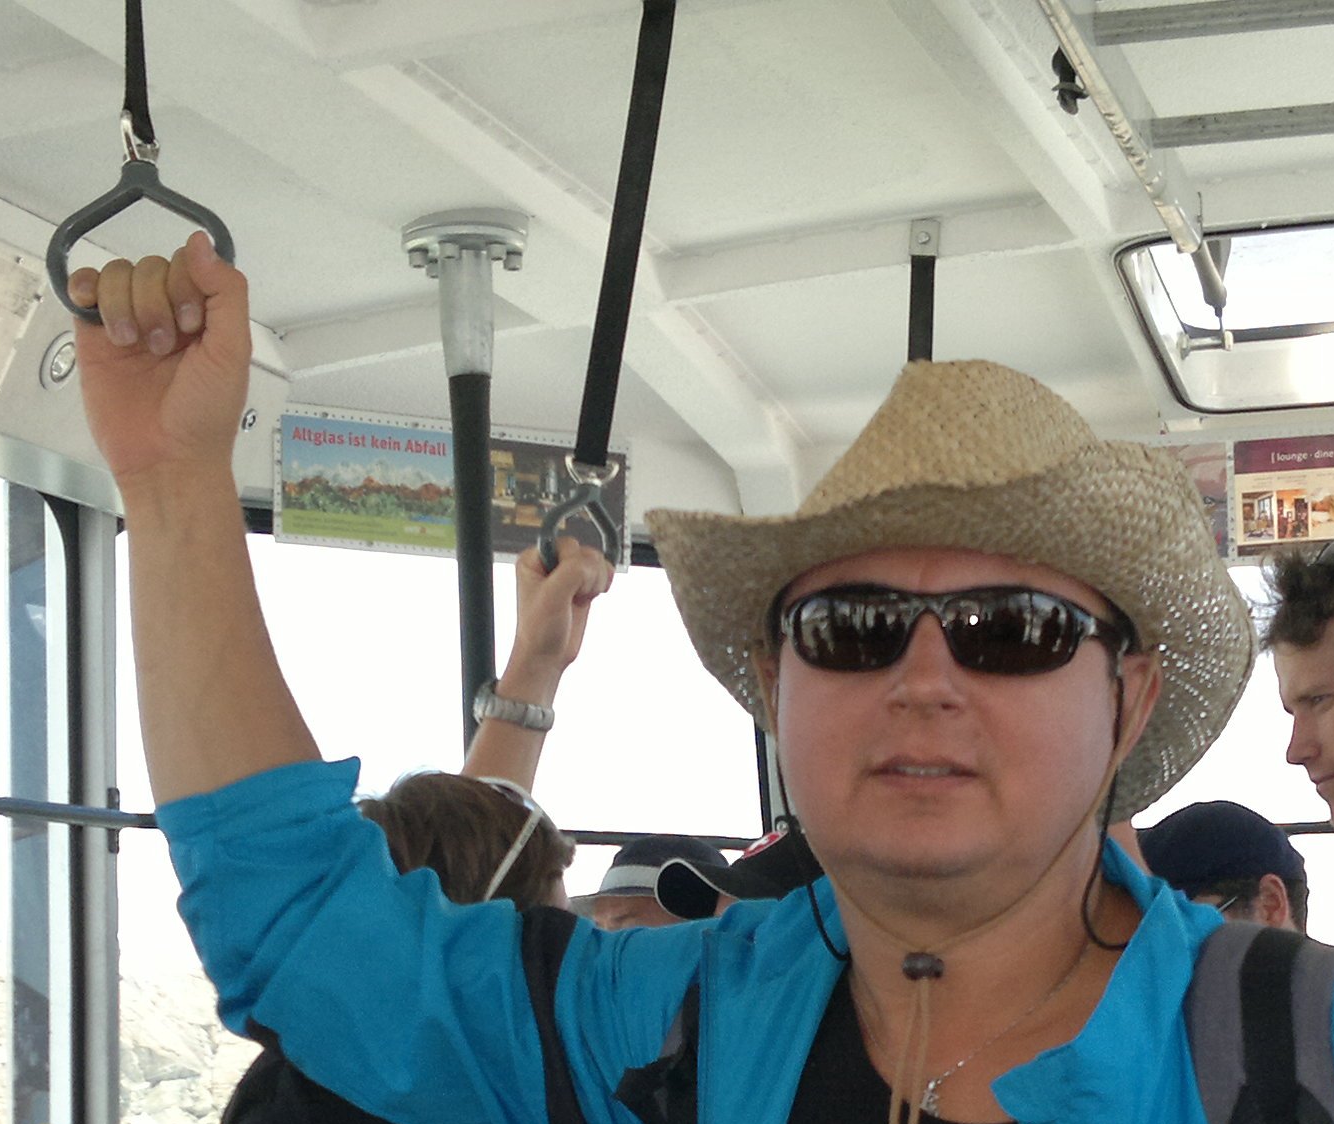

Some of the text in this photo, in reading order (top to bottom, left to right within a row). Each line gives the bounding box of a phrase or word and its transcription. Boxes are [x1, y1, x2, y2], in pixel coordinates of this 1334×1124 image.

[292, 426, 447, 456] Altglas ist kein Abfall
[1276, 452, 1308, 463] lounge
[1314, 450, 1334, 459] dine
